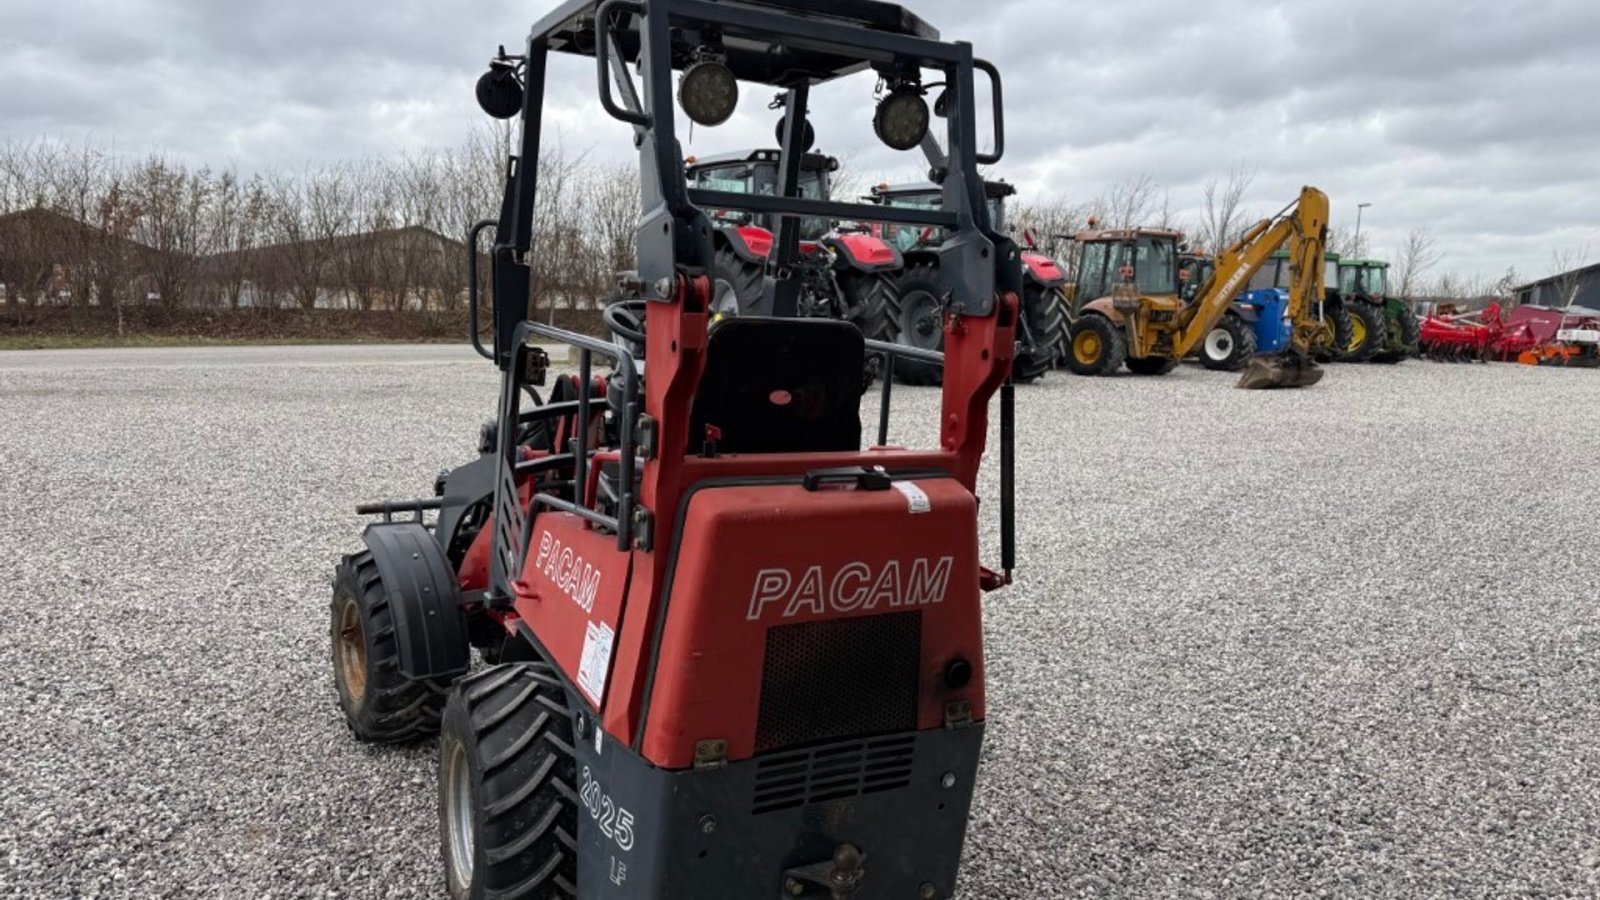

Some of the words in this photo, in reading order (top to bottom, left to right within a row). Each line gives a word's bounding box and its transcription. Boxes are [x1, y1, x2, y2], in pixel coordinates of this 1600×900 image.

[536, 530, 601, 614] PACAM
[746, 556, 954, 621] PACAM
[580, 765, 634, 851] 2025
